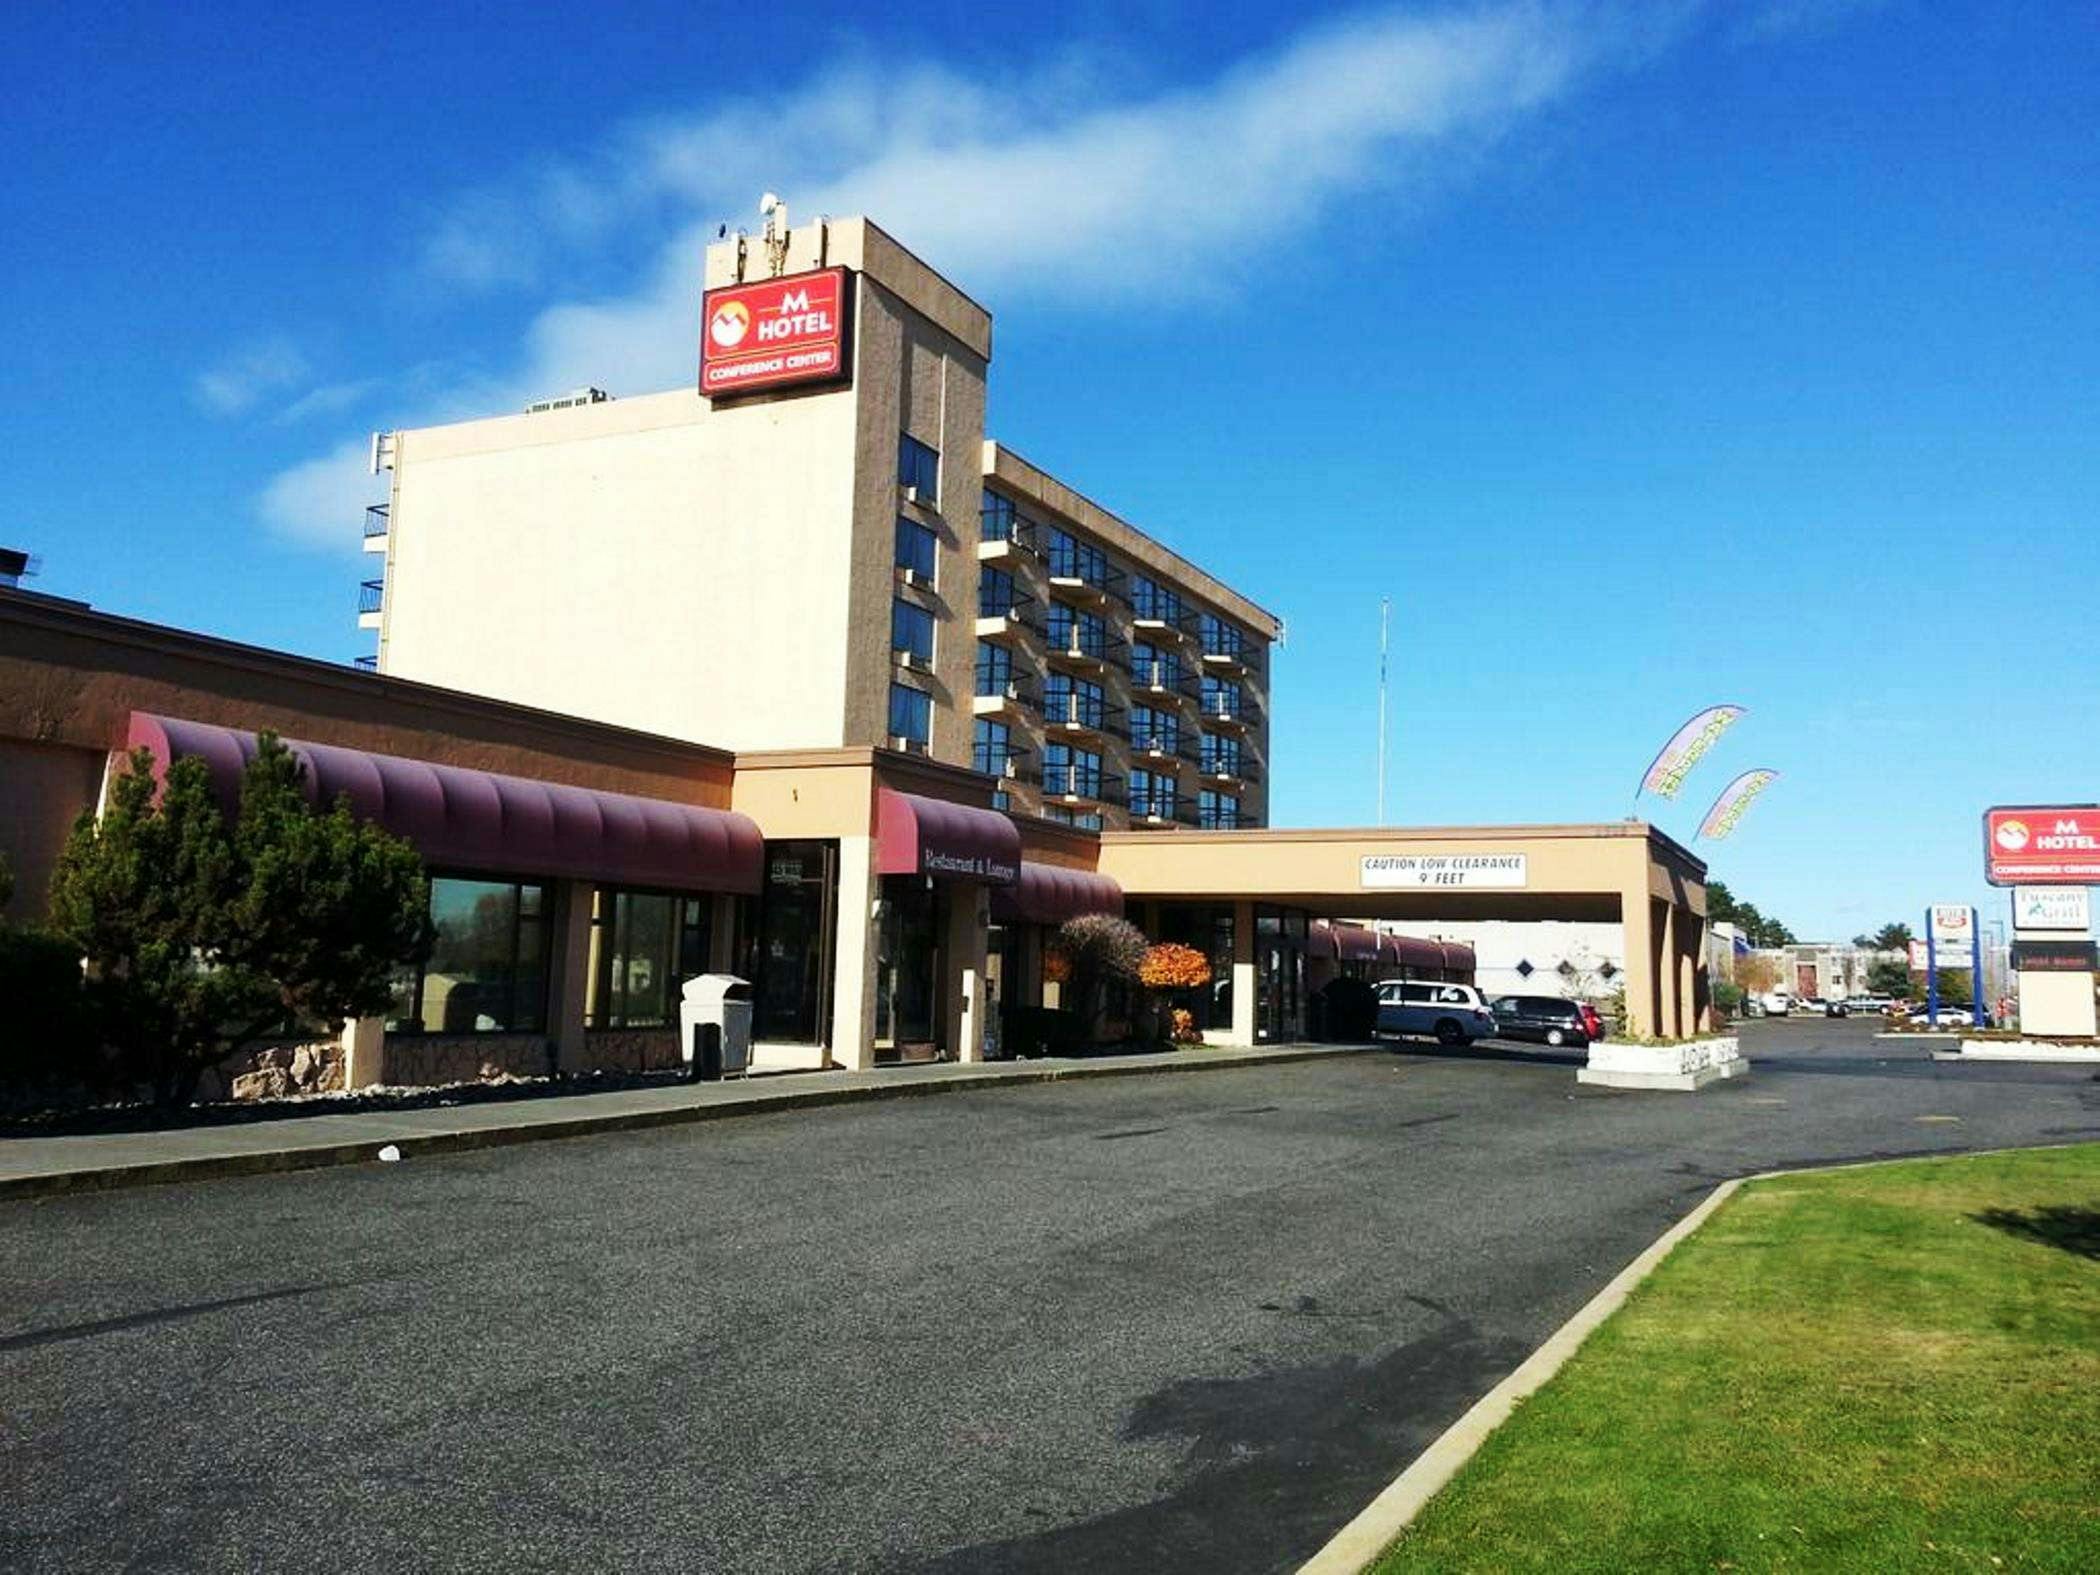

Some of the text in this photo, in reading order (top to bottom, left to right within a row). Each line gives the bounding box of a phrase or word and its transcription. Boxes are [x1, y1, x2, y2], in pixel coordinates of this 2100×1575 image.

[781, 289, 809, 314] M
[757, 312, 832, 341] HOTEL
[709, 351, 832, 380] CONFERENCE CENTER
[2055, 819, 2079, 834] M
[2036, 835, 2100, 849] HOTEL
[1365, 857, 1521, 870] CAUTION LOW CLEARANCE
[1435, 872, 1465, 884] FEET
